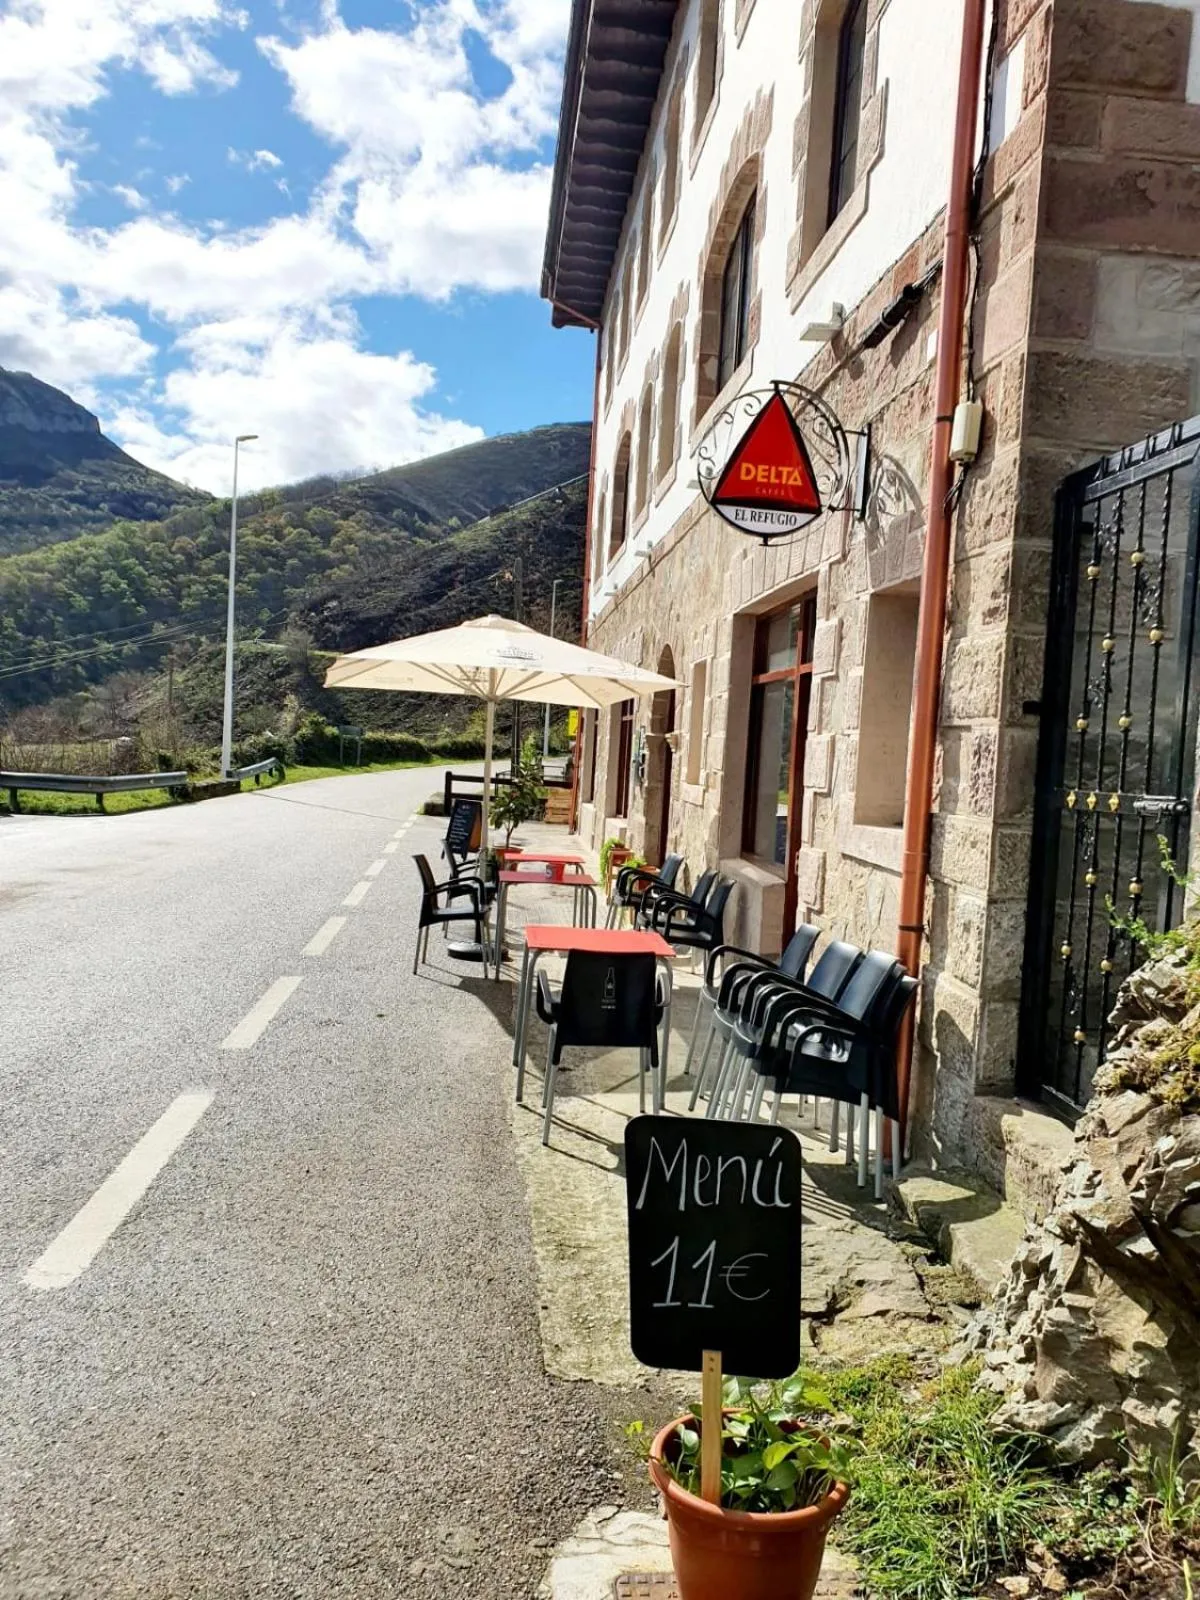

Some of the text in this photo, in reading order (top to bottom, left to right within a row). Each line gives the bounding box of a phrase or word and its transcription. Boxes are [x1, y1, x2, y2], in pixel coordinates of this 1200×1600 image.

[740, 462, 802, 486] DELTA
[734, 508, 797, 526] EL REFUGIO
[635, 1136, 792, 1211] Menú
